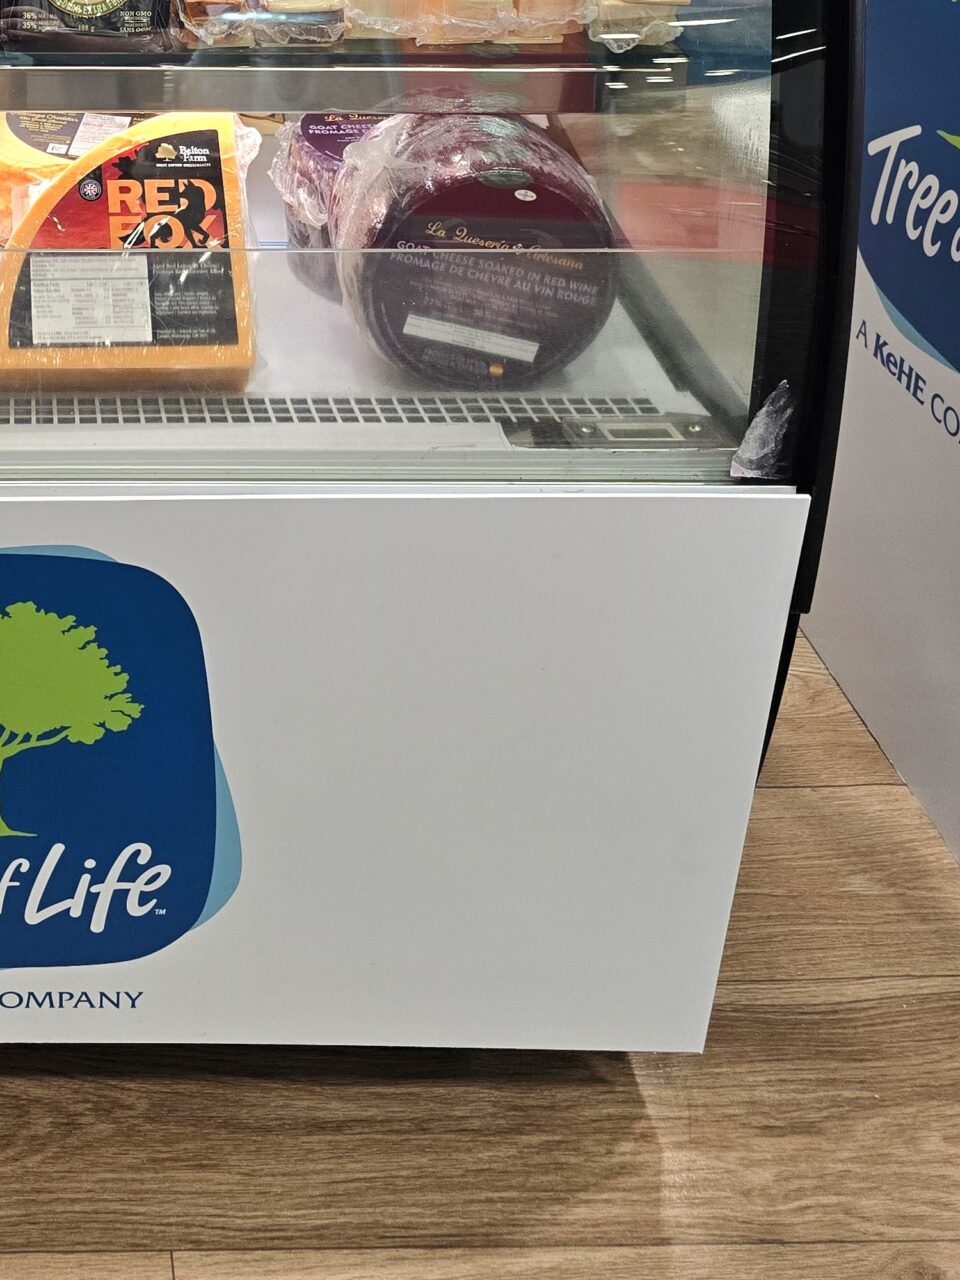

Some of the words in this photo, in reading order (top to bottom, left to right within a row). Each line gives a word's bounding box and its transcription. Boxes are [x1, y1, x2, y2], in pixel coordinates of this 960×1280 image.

[22, 11, 38, 20] 36%
[22, 21, 38, 30] 35%
[178, 144, 210, 156] Belton
[183, 153, 208, 162] Farm
[106, 178, 217, 214] RED
[108, 214, 221, 249] FOX
[425, 221, 447, 239] La
[389, 251, 448, 274] FROMAGE
[449, 264, 465, 277] DE
[513, 280, 531, 292] AU
[533, 284, 554, 299] VIN
[556, 289, 598, 307] ROUGE
[396, 240, 431, 253] GOAT
[433, 251, 476, 267] CHEESE
[477, 258, 524, 277] SOAKED
[526, 268, 541, 280] IN
[542, 273, 567, 289] RED
[567, 280, 600, 295] WINE
[855, 319, 868, 350] A
[873, 331, 927, 407] KeHE
[23, 842, 173, 934] Life
